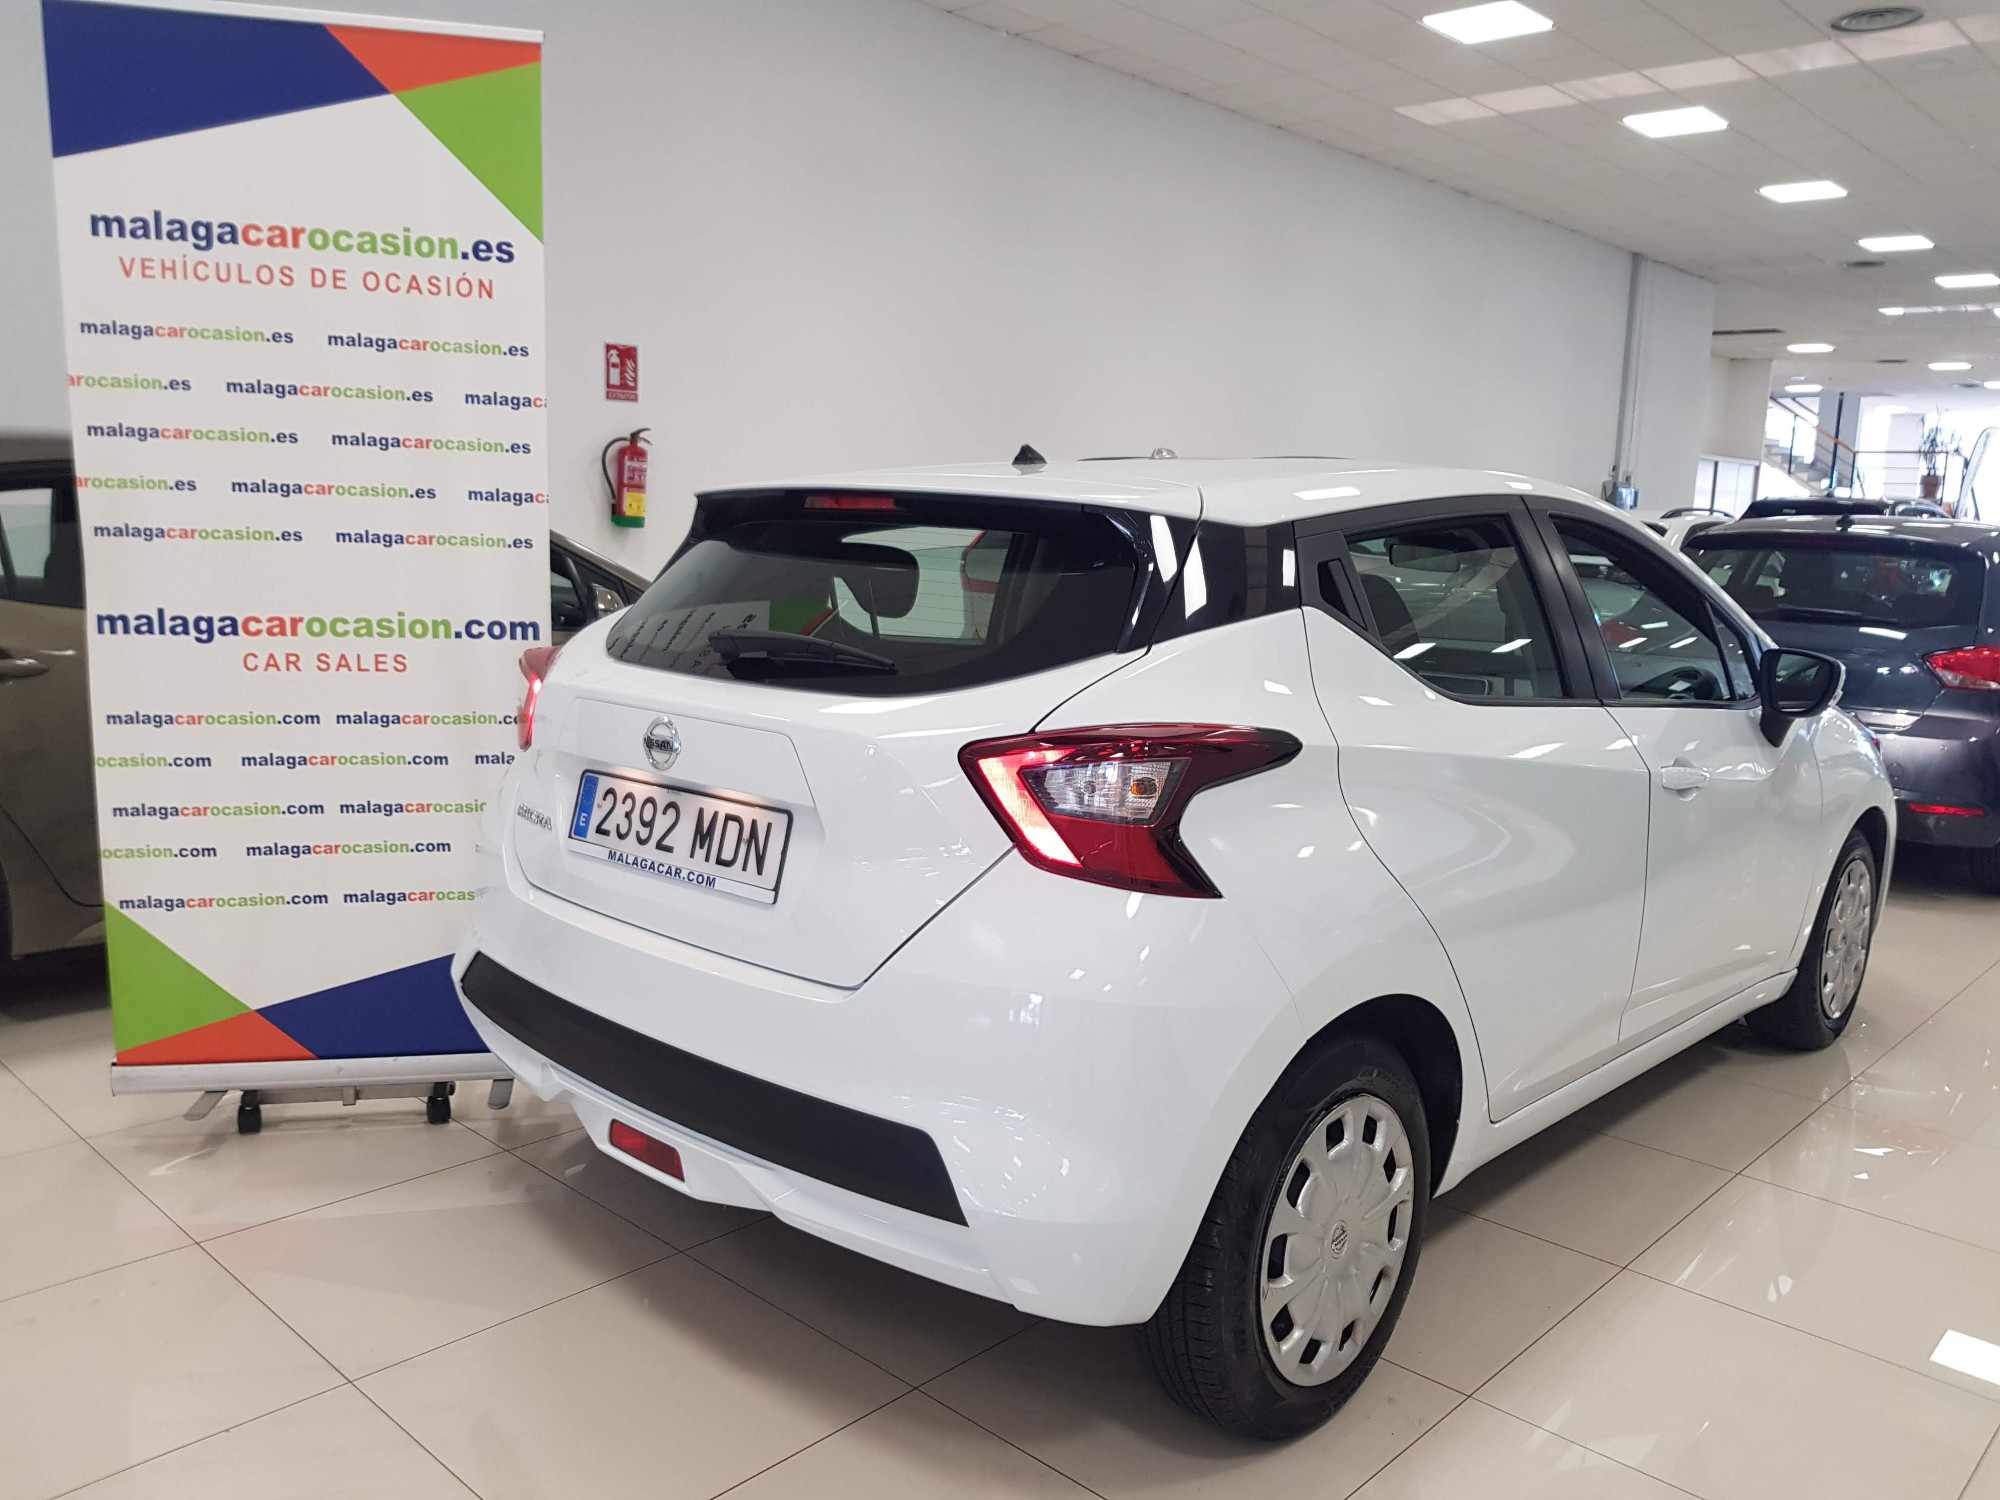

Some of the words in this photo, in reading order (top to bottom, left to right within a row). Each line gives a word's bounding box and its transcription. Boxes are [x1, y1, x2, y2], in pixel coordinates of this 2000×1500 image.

[90, 210, 516, 264] malagacarocasion.es
[118, 255, 296, 288] VEHÍCULOS
[311, 267, 348, 290] DE
[363, 271, 494, 300] OCASIÓN
[79, 319, 294, 345] malagacarocasion.es
[327, 332, 530, 358] malagacarocasion.es
[226, 379, 434, 403] malagacarocasion.es
[87, 423, 298, 444] malagacarocasion.es
[332, 432, 532, 455] malagacarocasion.es
[231, 479, 437, 500] malagacarocasion.es
[94, 523, 303, 543] malagacarocasion.es
[336, 530, 534, 550] malagacarocasion.es
[97, 608, 539, 642] malagacarocasion.com
[243, 652, 302, 673] CAR
[316, 652, 409, 673] SALES
[106, 711, 321, 729] malagacarocasion.com
[643, 736, 673, 750] NISSAN
[96, 752, 213, 769] ocasion.com
[241, 751, 449, 770] malagacarocasion.com
[113, 803, 325, 821] malagacarocasion.com
[579, 812, 589, 827] E
[595, 787, 681, 853] 2392
[689, 806, 773, 876] MDN
[102, 844, 219, 860] ocasion.com
[246, 840, 452, 859] malagacarocasion.com
[607, 849, 717, 888] MALAGACAR.COM
[118, 892, 329, 913] malagacarocasion.com
